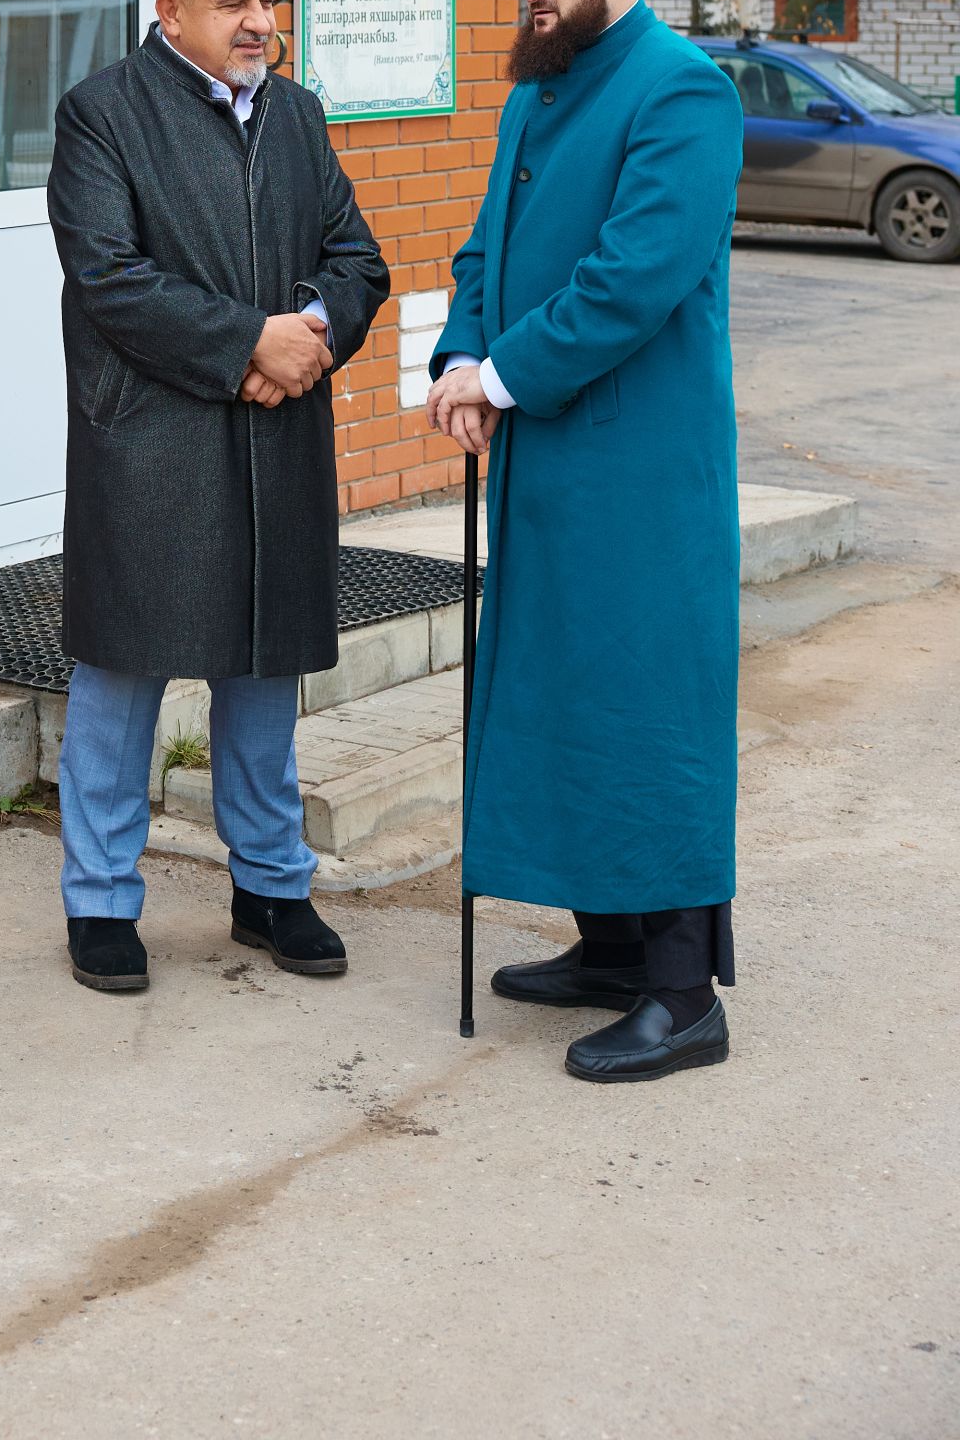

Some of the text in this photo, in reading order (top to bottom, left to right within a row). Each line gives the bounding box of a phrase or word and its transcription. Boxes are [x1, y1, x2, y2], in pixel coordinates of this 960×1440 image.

[315, 10, 442, 28] эшләрдән яхшырак итеп
[316, 29, 398, 48] кайтарачакбыз.
